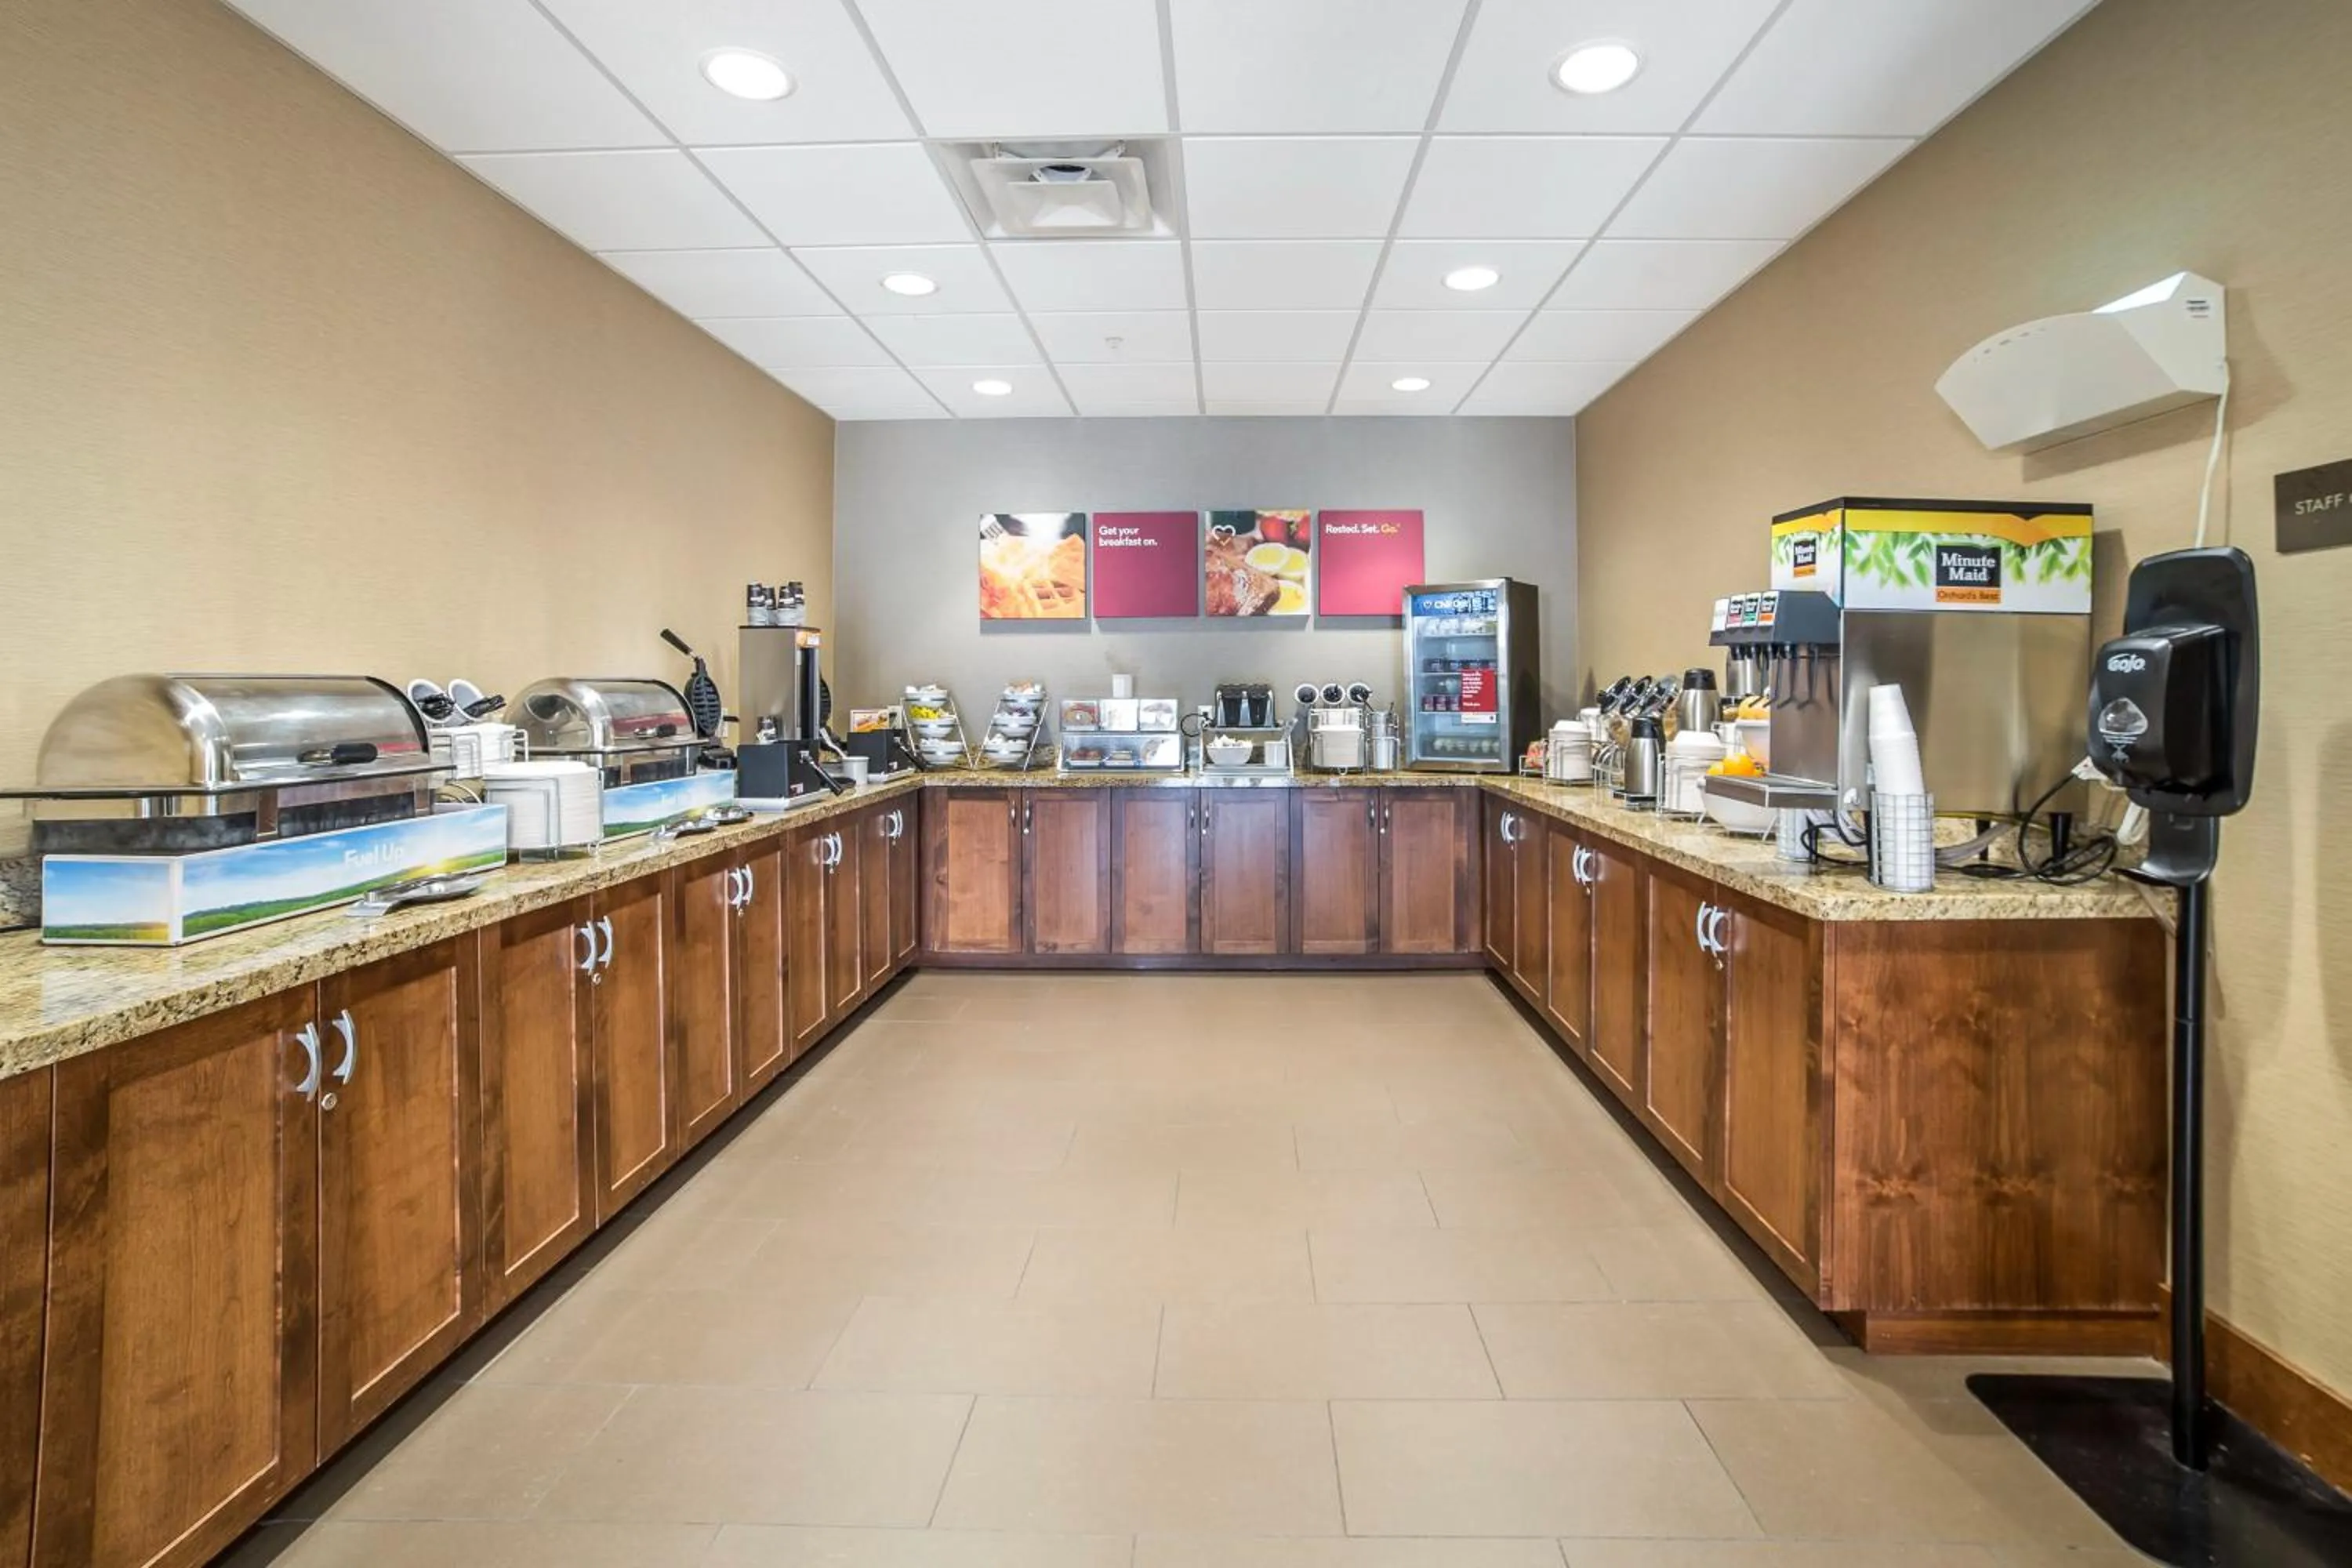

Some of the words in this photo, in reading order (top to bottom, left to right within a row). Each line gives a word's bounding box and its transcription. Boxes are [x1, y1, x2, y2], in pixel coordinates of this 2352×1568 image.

[2294, 492, 2344, 516] STAFF
[1098, 525, 1117, 535] Get
[1118, 527, 1140, 538] your
[1325, 523, 1360, 534] Rested.
[1361, 523, 1380, 534] Set.
[1098, 536, 1142, 546] breakfast
[1143, 538, 1158, 546] on.
[1940, 551, 1997, 568] Minute
[1948, 567, 1990, 582] Maid
[343, 843, 379, 867] Fuel
[381, 842, 404, 869] Up
